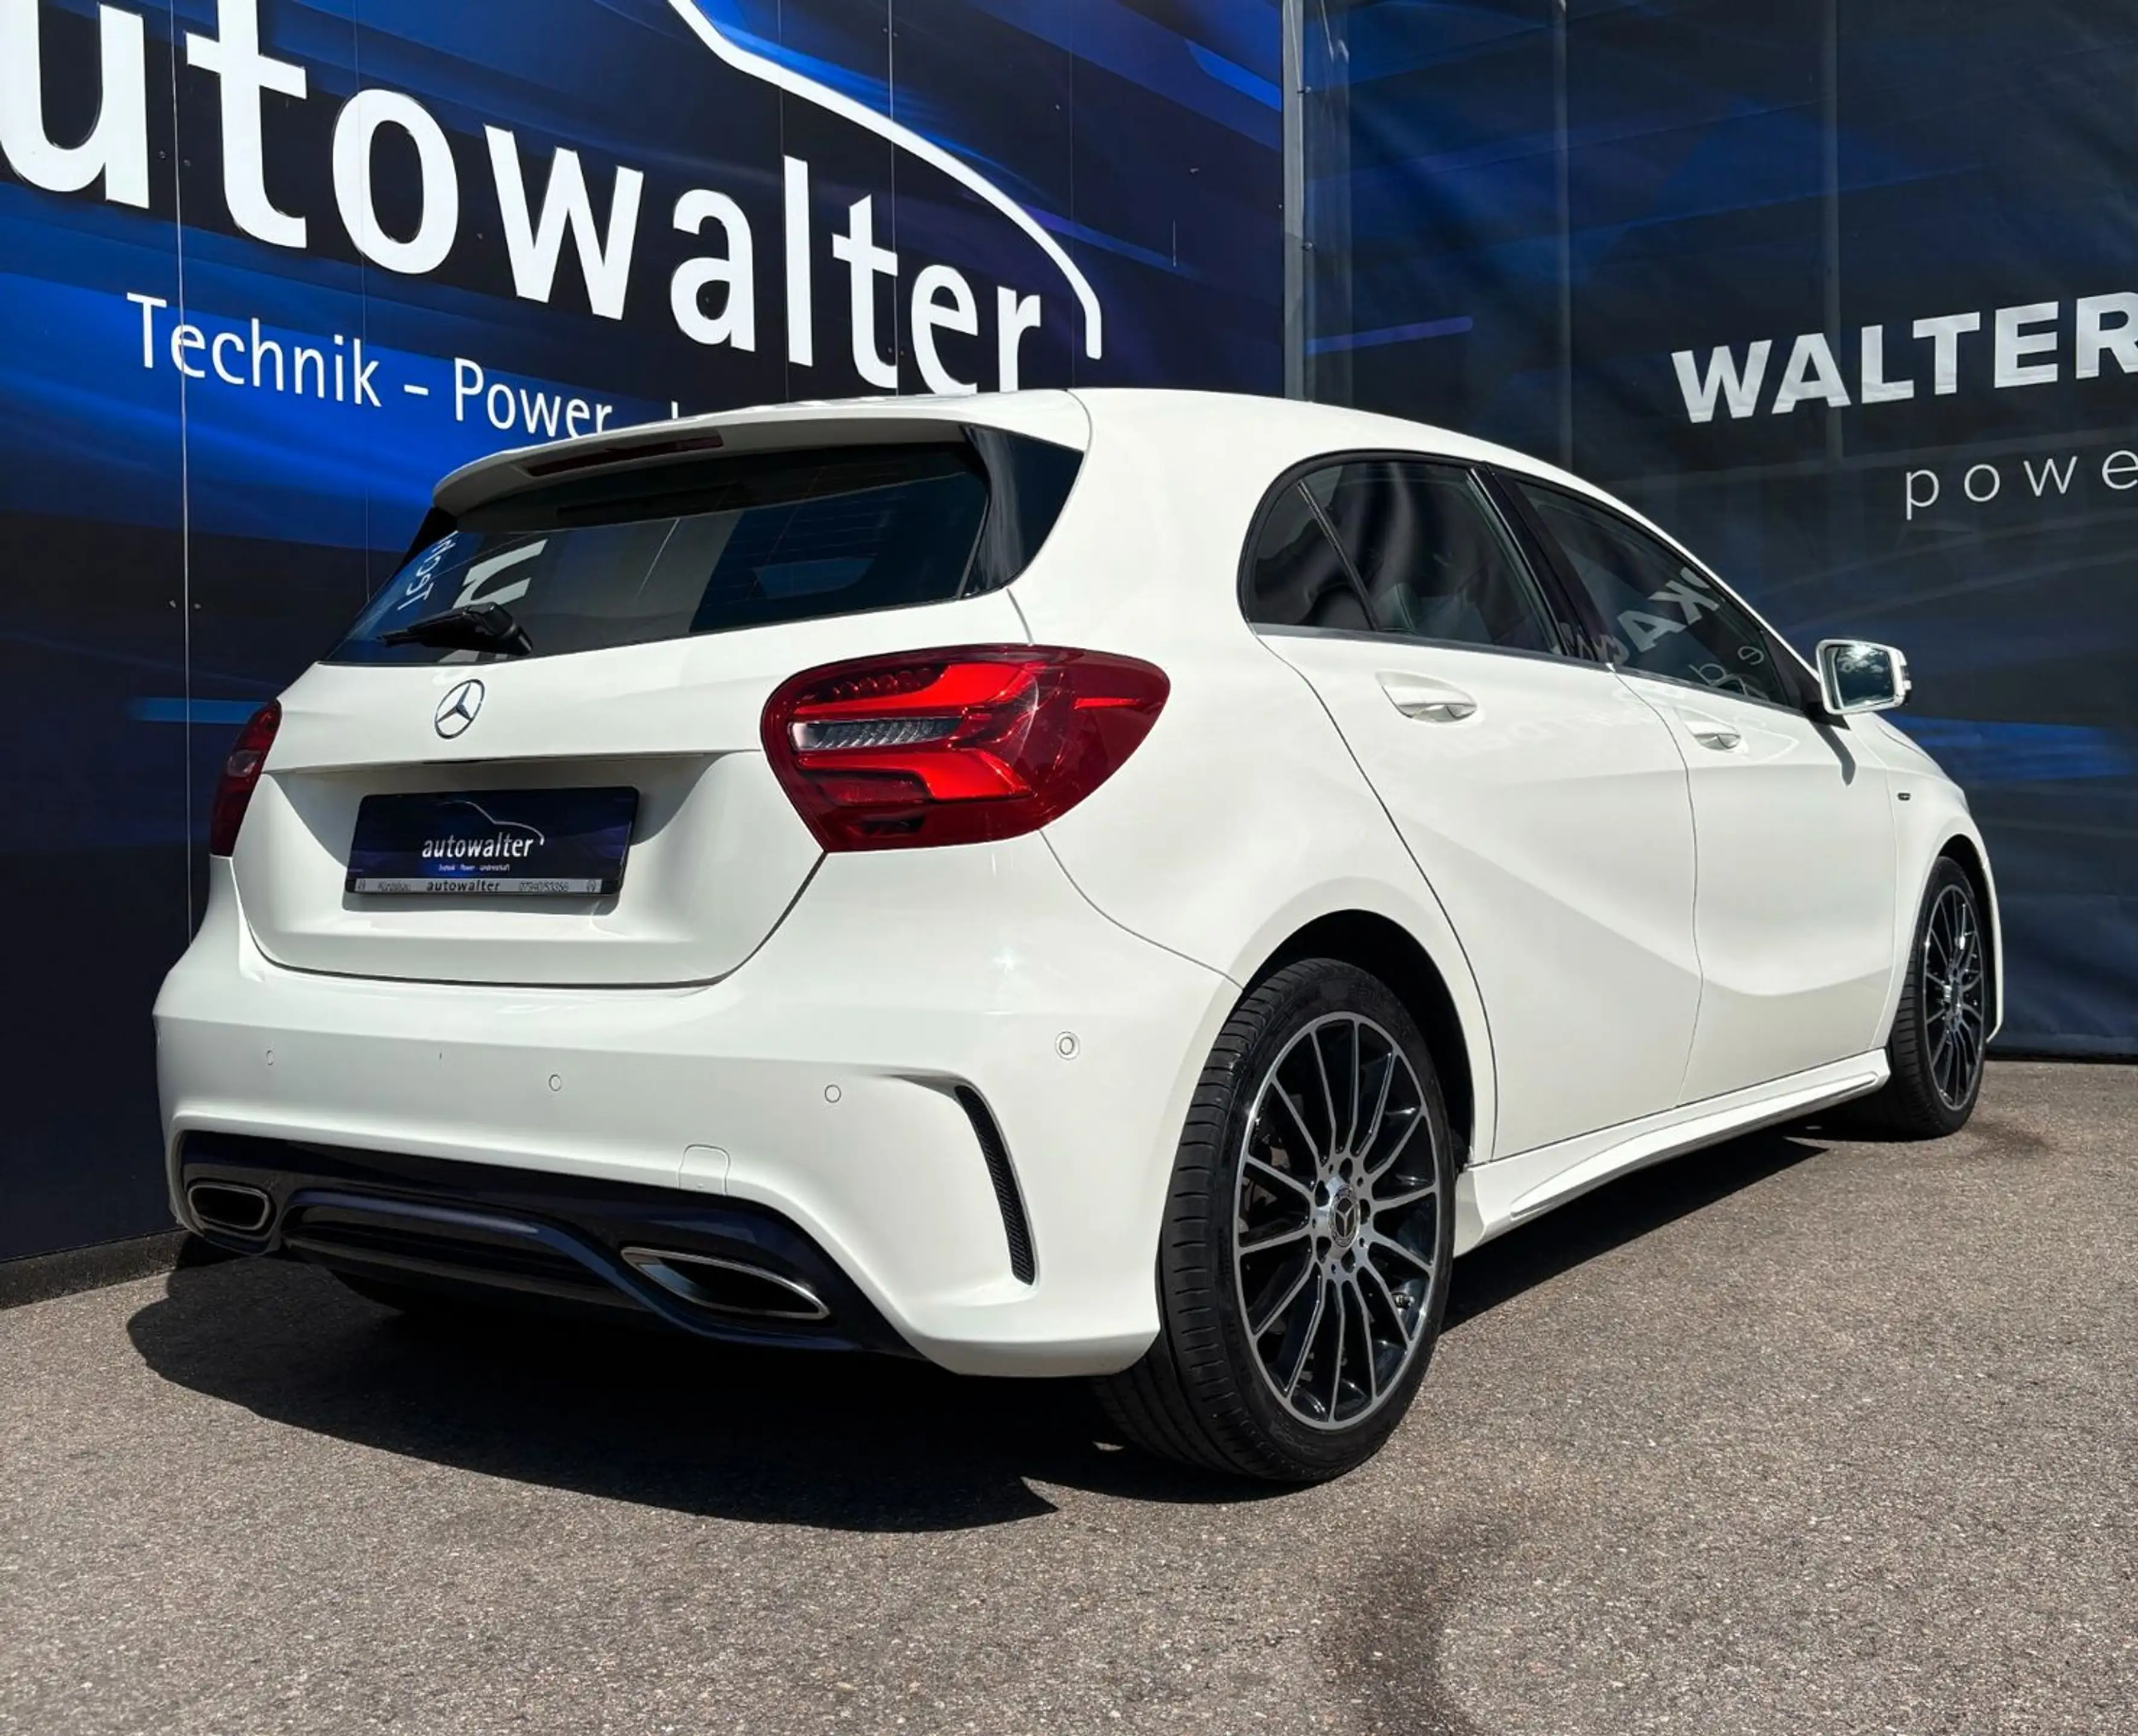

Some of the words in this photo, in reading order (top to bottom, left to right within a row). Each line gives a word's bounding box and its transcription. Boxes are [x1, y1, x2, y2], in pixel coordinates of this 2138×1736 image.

[127, 292, 382, 408] Technik
[454, 357, 613, 438] Power
[1670, 292, 2138, 424] WALTER
[1905, 448, 2138, 521] powe
[421, 831, 534, 858] autowalter
[426, 880, 500, 892] autowalter
